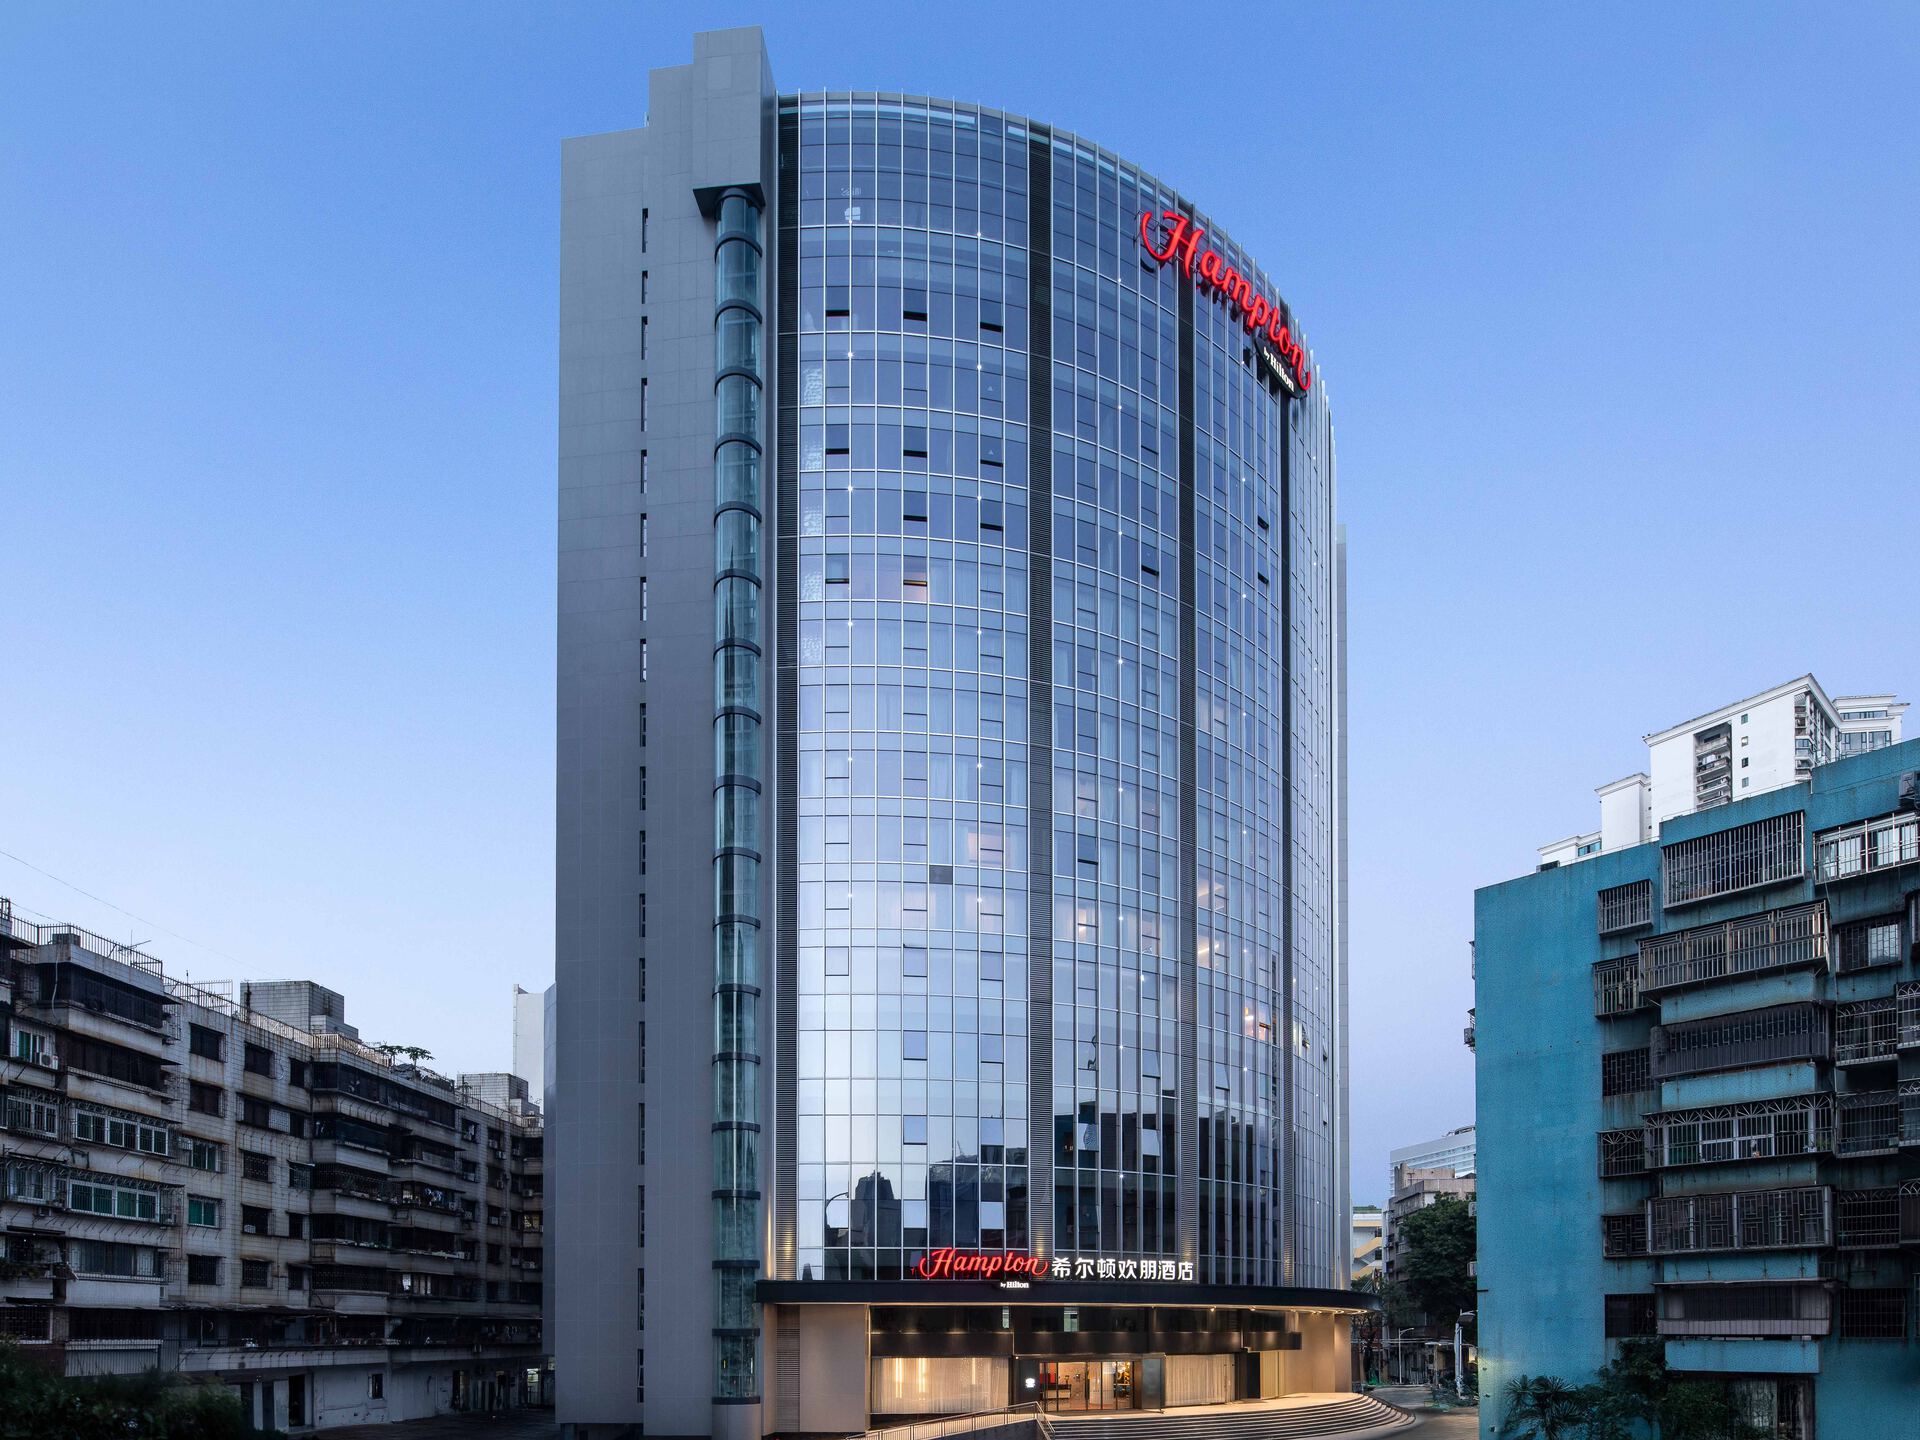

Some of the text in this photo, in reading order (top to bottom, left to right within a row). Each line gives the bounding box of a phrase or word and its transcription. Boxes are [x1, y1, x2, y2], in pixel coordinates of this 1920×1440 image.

[1141, 211, 1311, 390] Hampton
[1270, 353, 1295, 392] Hilton
[919, 1247, 1048, 1278] Hampton
[1051, 1257, 1194, 1280] 希尔顿欢朋酒店
[1006, 1281, 1030, 1289] Hilton
